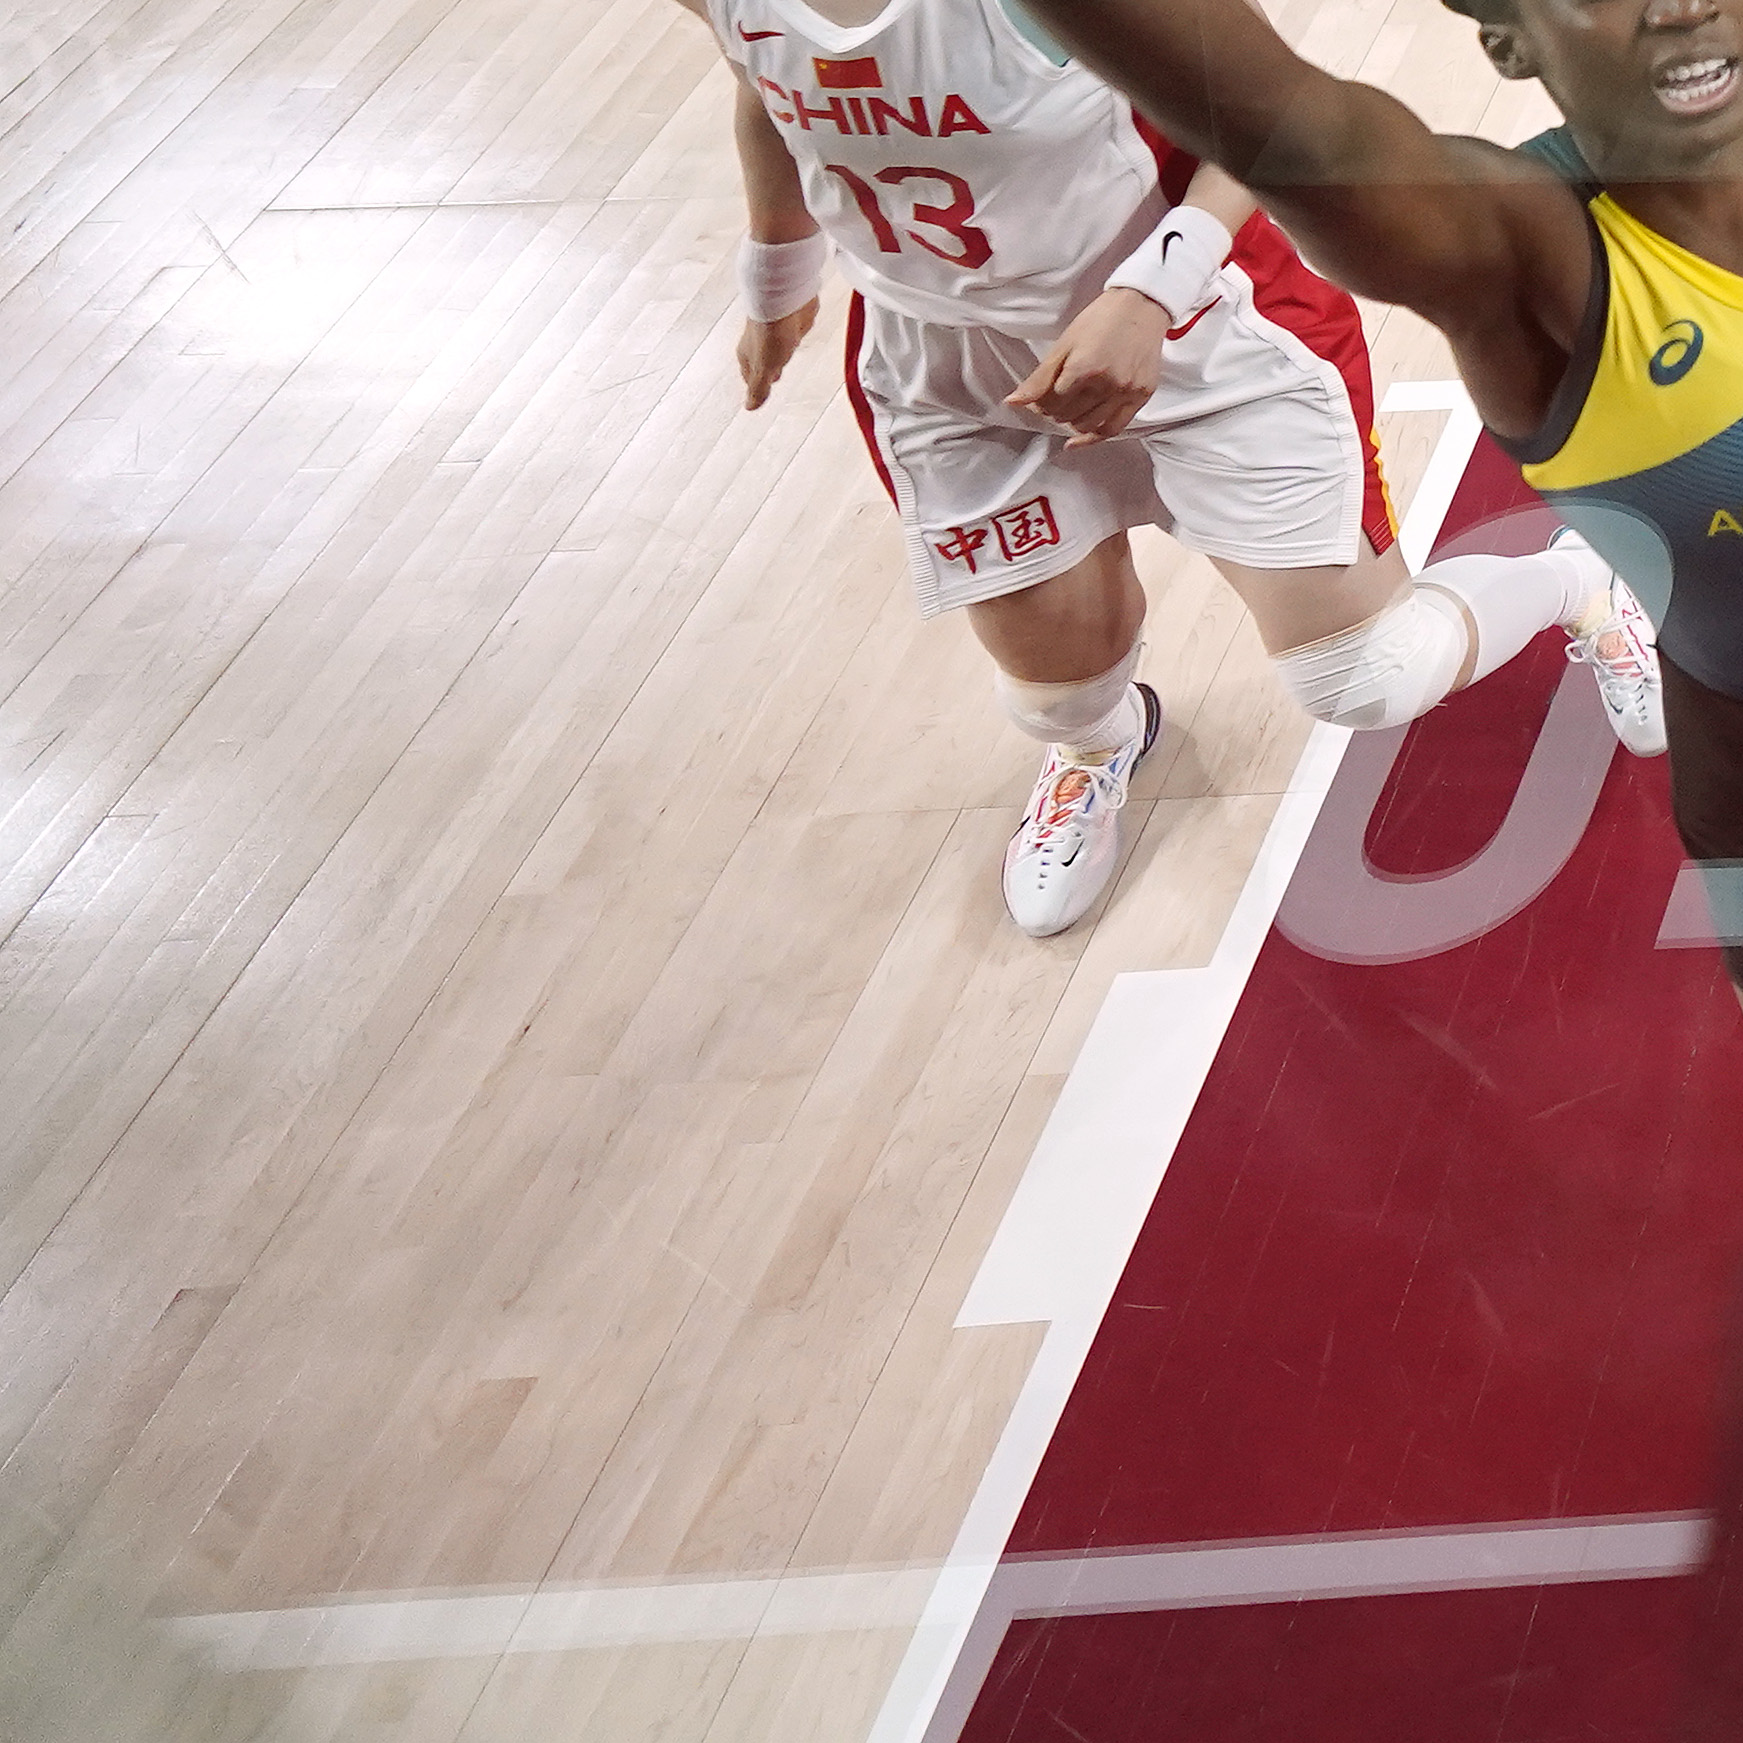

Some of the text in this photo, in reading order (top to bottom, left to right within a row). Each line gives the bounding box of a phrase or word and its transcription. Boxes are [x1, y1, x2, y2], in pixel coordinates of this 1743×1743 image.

[757, 76, 992, 138] CHINA
[823, 164, 994, 270] 13
[935, 495, 1061, 575] 中国
